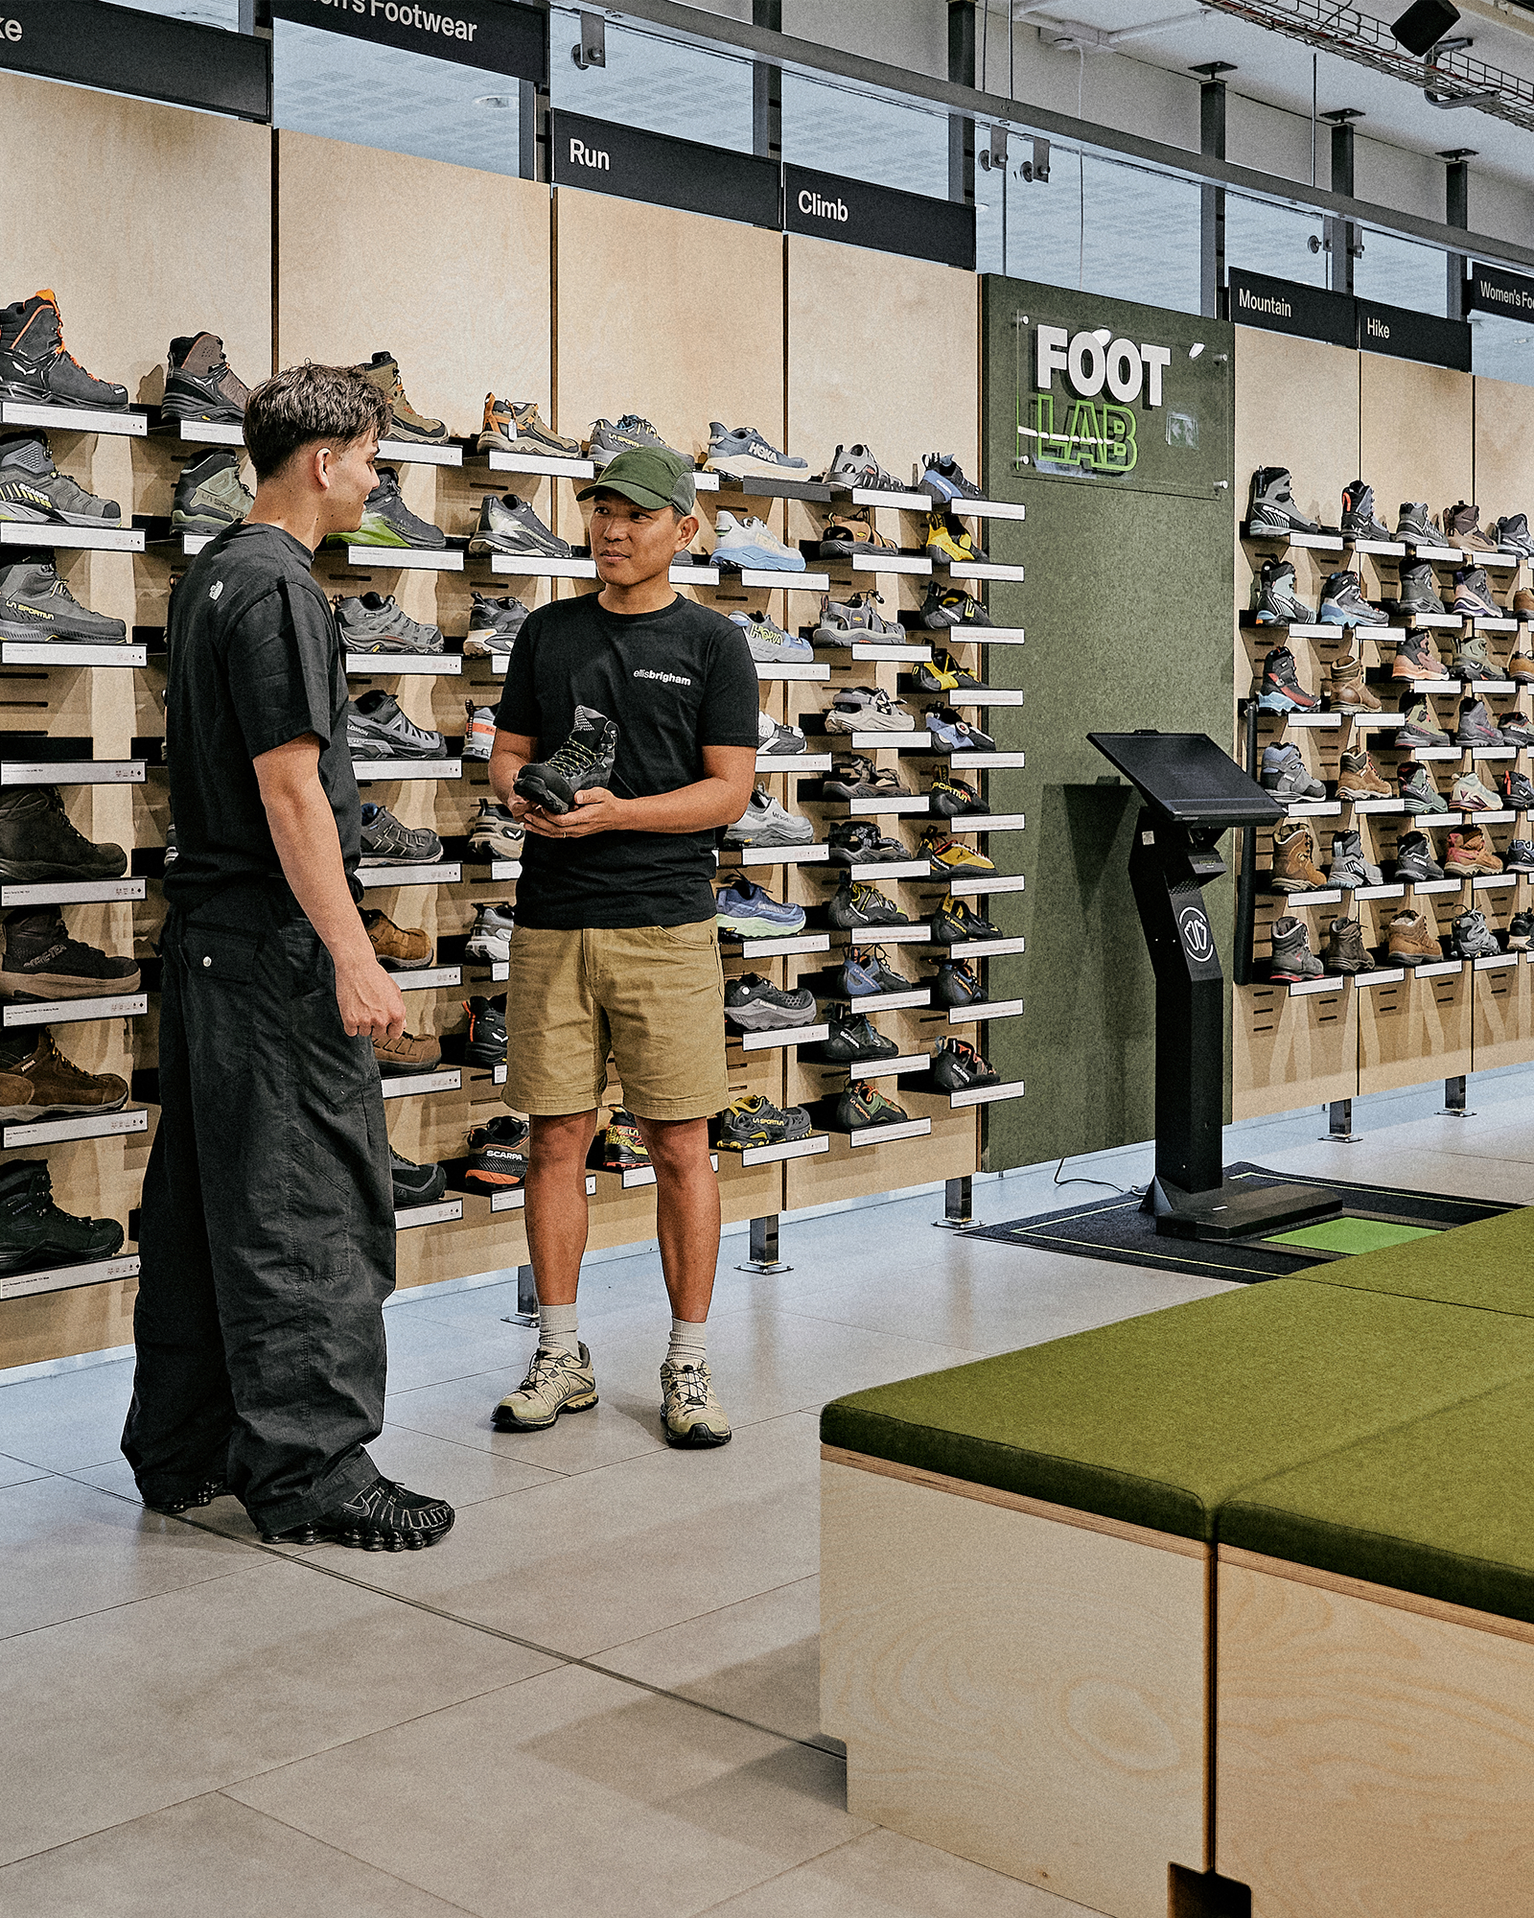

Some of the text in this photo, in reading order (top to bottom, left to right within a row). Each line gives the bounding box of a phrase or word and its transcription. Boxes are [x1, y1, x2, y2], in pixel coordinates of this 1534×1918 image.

[370, 0, 478, 42] Footwear
[569, 138, 610, 171] Run
[798, 190, 849, 222] Climb
[1239, 288, 1292, 318] Mountain
[1480, 280, 1521, 306] Women's
[1367, 317, 1390, 339] Hike
[1037, 324, 1171, 407] FOOT
[1037, 393, 1138, 472] LAB
[748, 441, 778, 464] HOKA
[633, 668, 692, 686] ellisbrigham
[346, 725, 369, 737] LOMON
[486, 1150, 523, 1161] SCARPA
